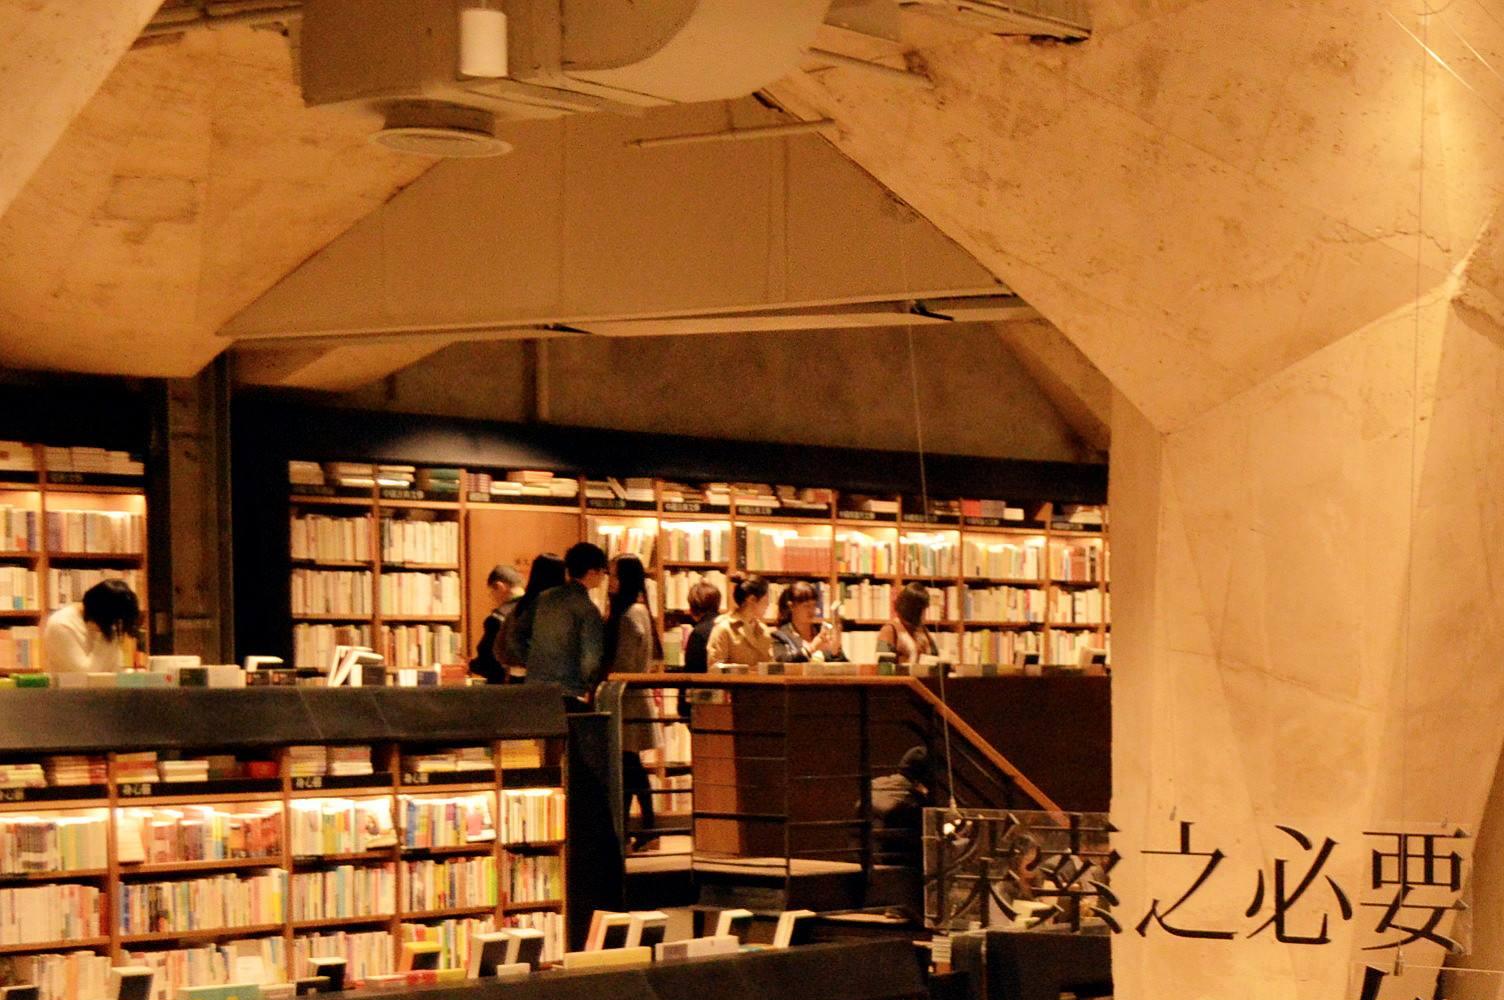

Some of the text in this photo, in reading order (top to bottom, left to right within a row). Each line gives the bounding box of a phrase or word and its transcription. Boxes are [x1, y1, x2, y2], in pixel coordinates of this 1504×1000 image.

[925, 811, 1471, 954] 探索之必要
